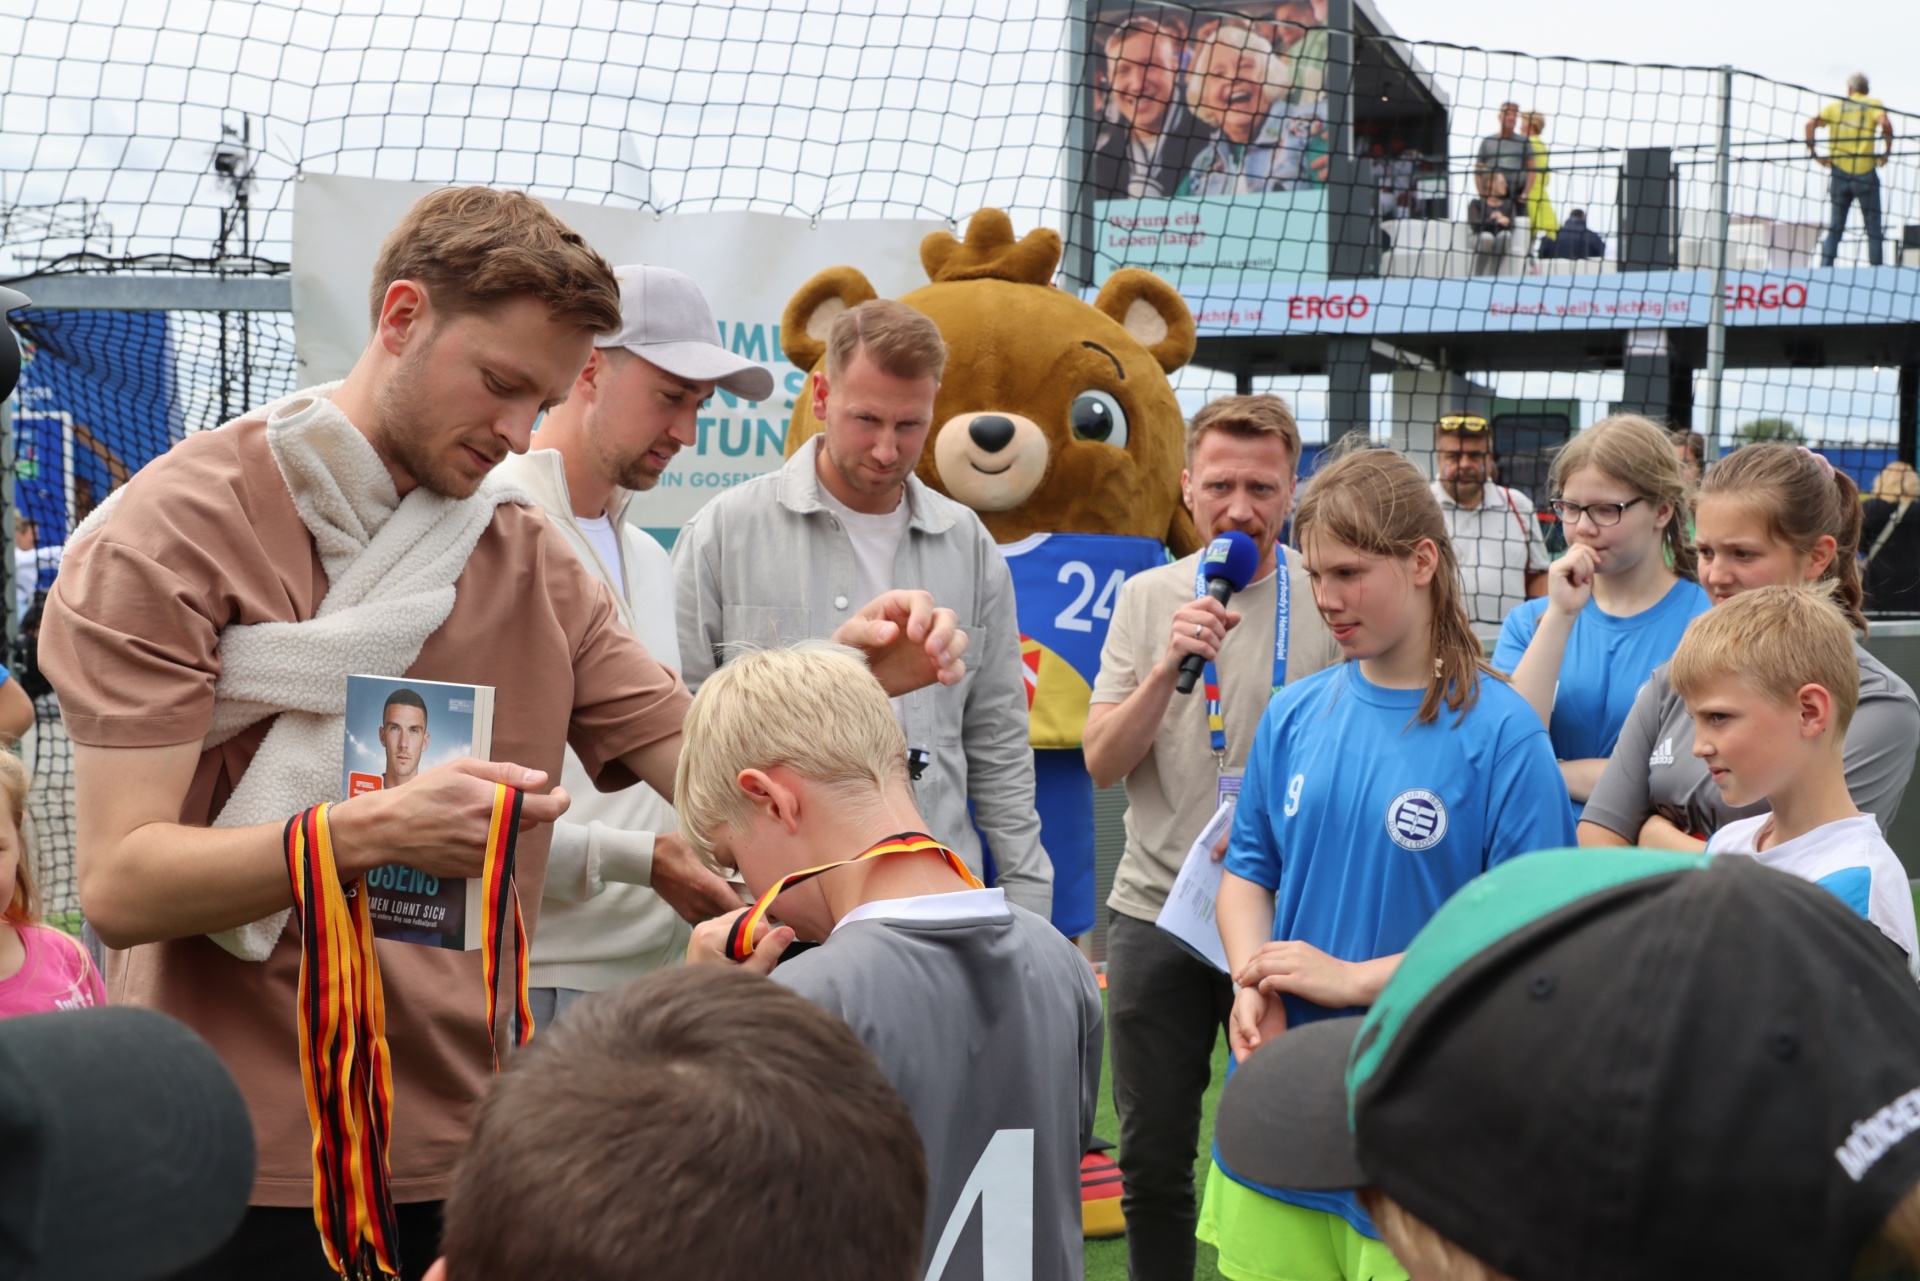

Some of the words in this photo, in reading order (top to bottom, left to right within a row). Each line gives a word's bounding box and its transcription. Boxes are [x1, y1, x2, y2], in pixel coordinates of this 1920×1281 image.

[1108, 214, 1168, 229] Warum
[1174, 210, 1200, 225] ein
[1108, 233, 1157, 248] Leben
[1287, 294, 1369, 321] ERGO
[1605, 299, 1662, 317] wichtig
[1724, 282, 1808, 311] ERGO
[1054, 560, 1126, 633] 24
[1277, 563, 1290, 614] Everybody's
[1275, 615, 1289, 660] Heimspiel
[1283, 773, 1305, 817] 9
[366, 863, 440, 897] OSENS
[391, 899, 422, 917] LOHNT
[422, 904, 446, 921] SICH
